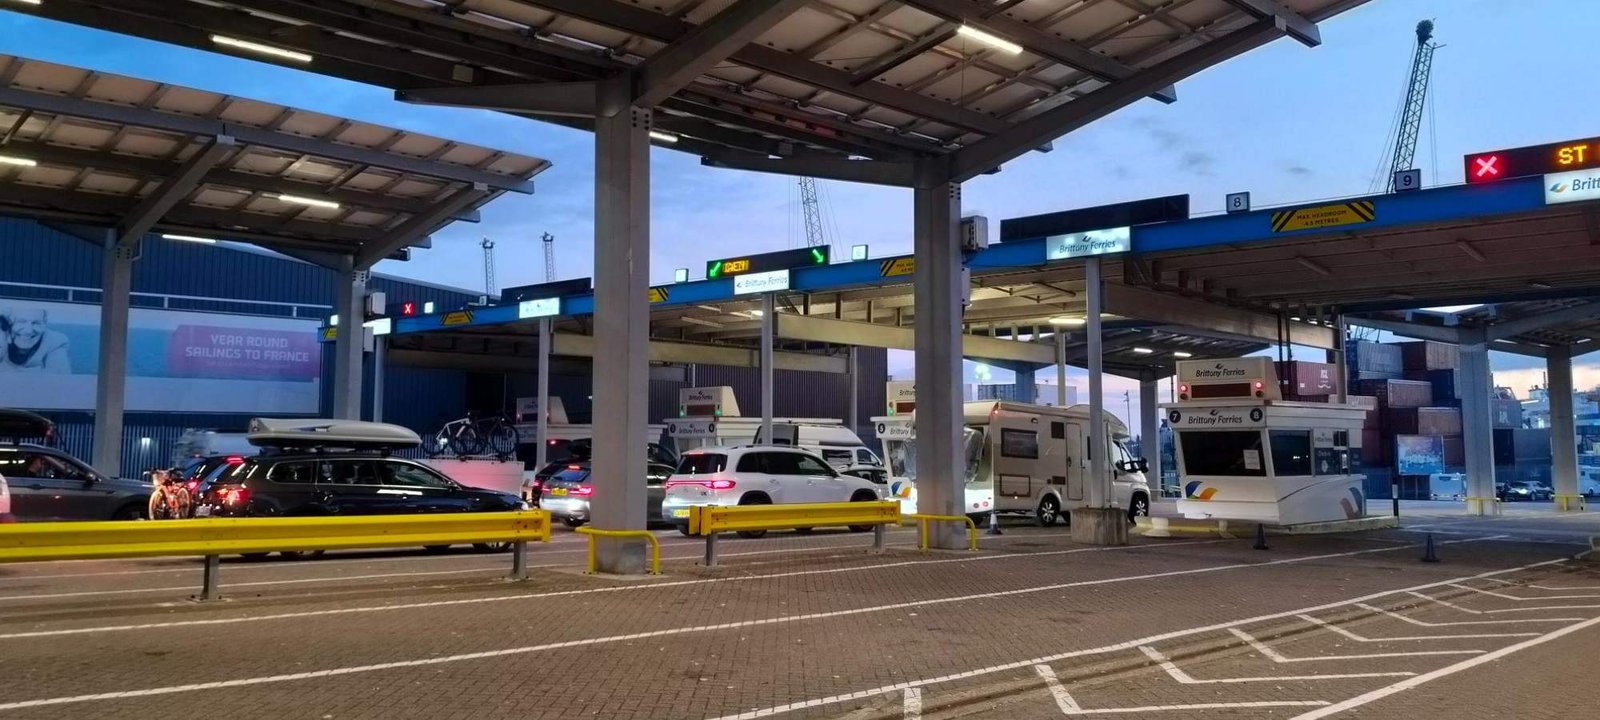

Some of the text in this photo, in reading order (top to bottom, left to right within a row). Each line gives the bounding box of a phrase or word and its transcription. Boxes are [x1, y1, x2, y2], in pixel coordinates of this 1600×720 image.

[1403, 175, 1411, 186] 9
[1572, 177, 1600, 191] Britt
[1233, 197, 1241, 207] 8
[1312, 210, 1347, 218] HEADROOM
[1059, 239, 1116, 254] Brittany Ferries
[768, 275, 788, 285] Ferries
[211, 334, 288, 348] YEAR ROUND
[185, 347, 309, 362] SAILINGS TO FRANCE
[1195, 367, 1246, 378] Brittany Ferries
[1188, 414, 1243, 425] Brittany Ferries
